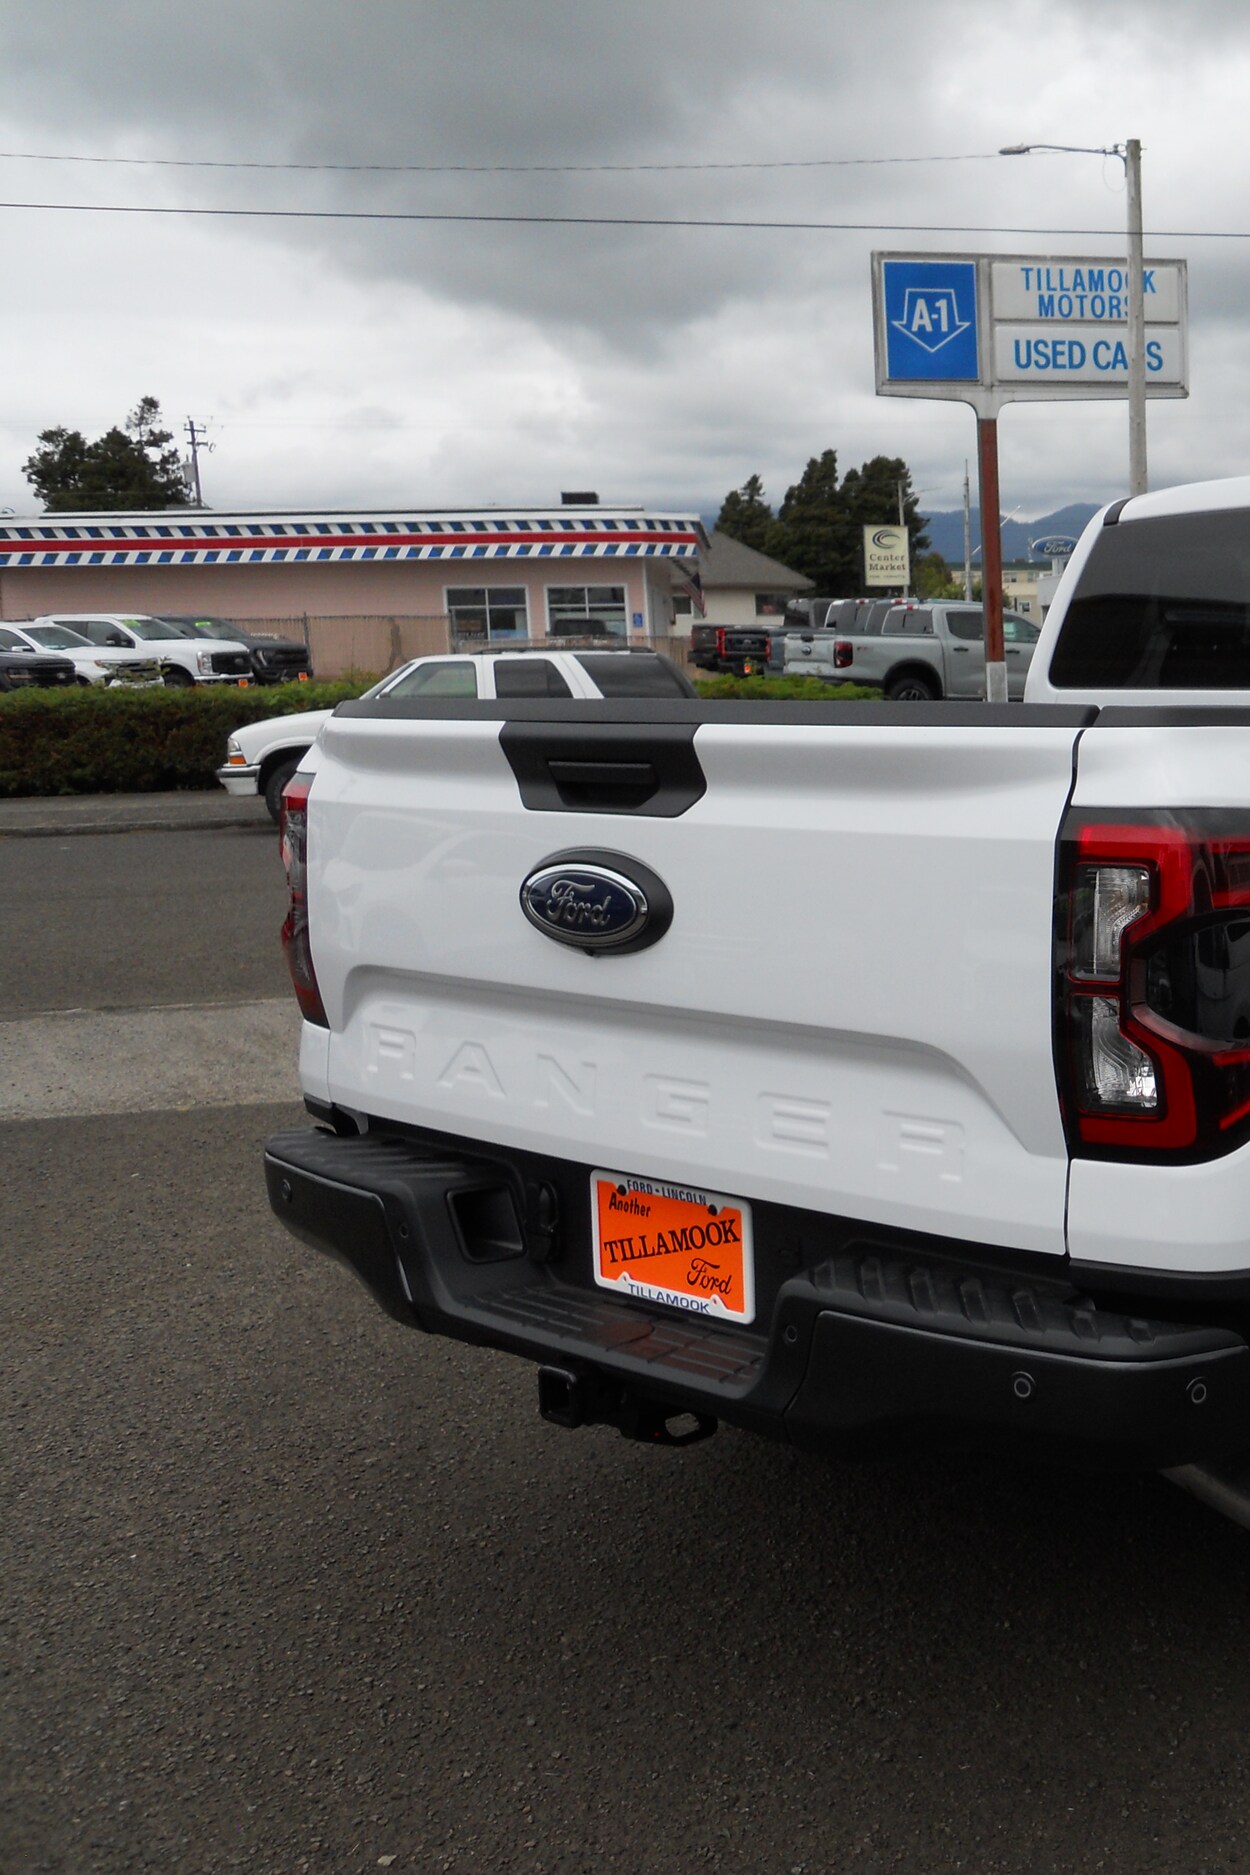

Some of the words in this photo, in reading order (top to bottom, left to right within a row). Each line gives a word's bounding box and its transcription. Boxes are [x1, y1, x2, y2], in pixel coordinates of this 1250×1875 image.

[1020, 267, 1157, 294] TILLAMOK
[911, 298, 949, 332] A-1
[1014, 339, 1086, 370] USED
[1092, 340, 1164, 371] CAS
[869, 553, 905, 562] Center
[1043, 540, 1073, 553] Ford
[869, 563, 906, 571] Market
[546, 878, 613, 927] Ford
[365, 1020, 966, 1184] RANGER
[608, 1192, 651, 1218] Another
[626, 1179, 653, 1195] FORD
[661, 1186, 707, 1206] LINCOLN
[604, 1219, 741, 1263] TILLAMOOK
[687, 1257, 732, 1295] Ford
[628, 1283, 711, 1313] TILLAMOOK
